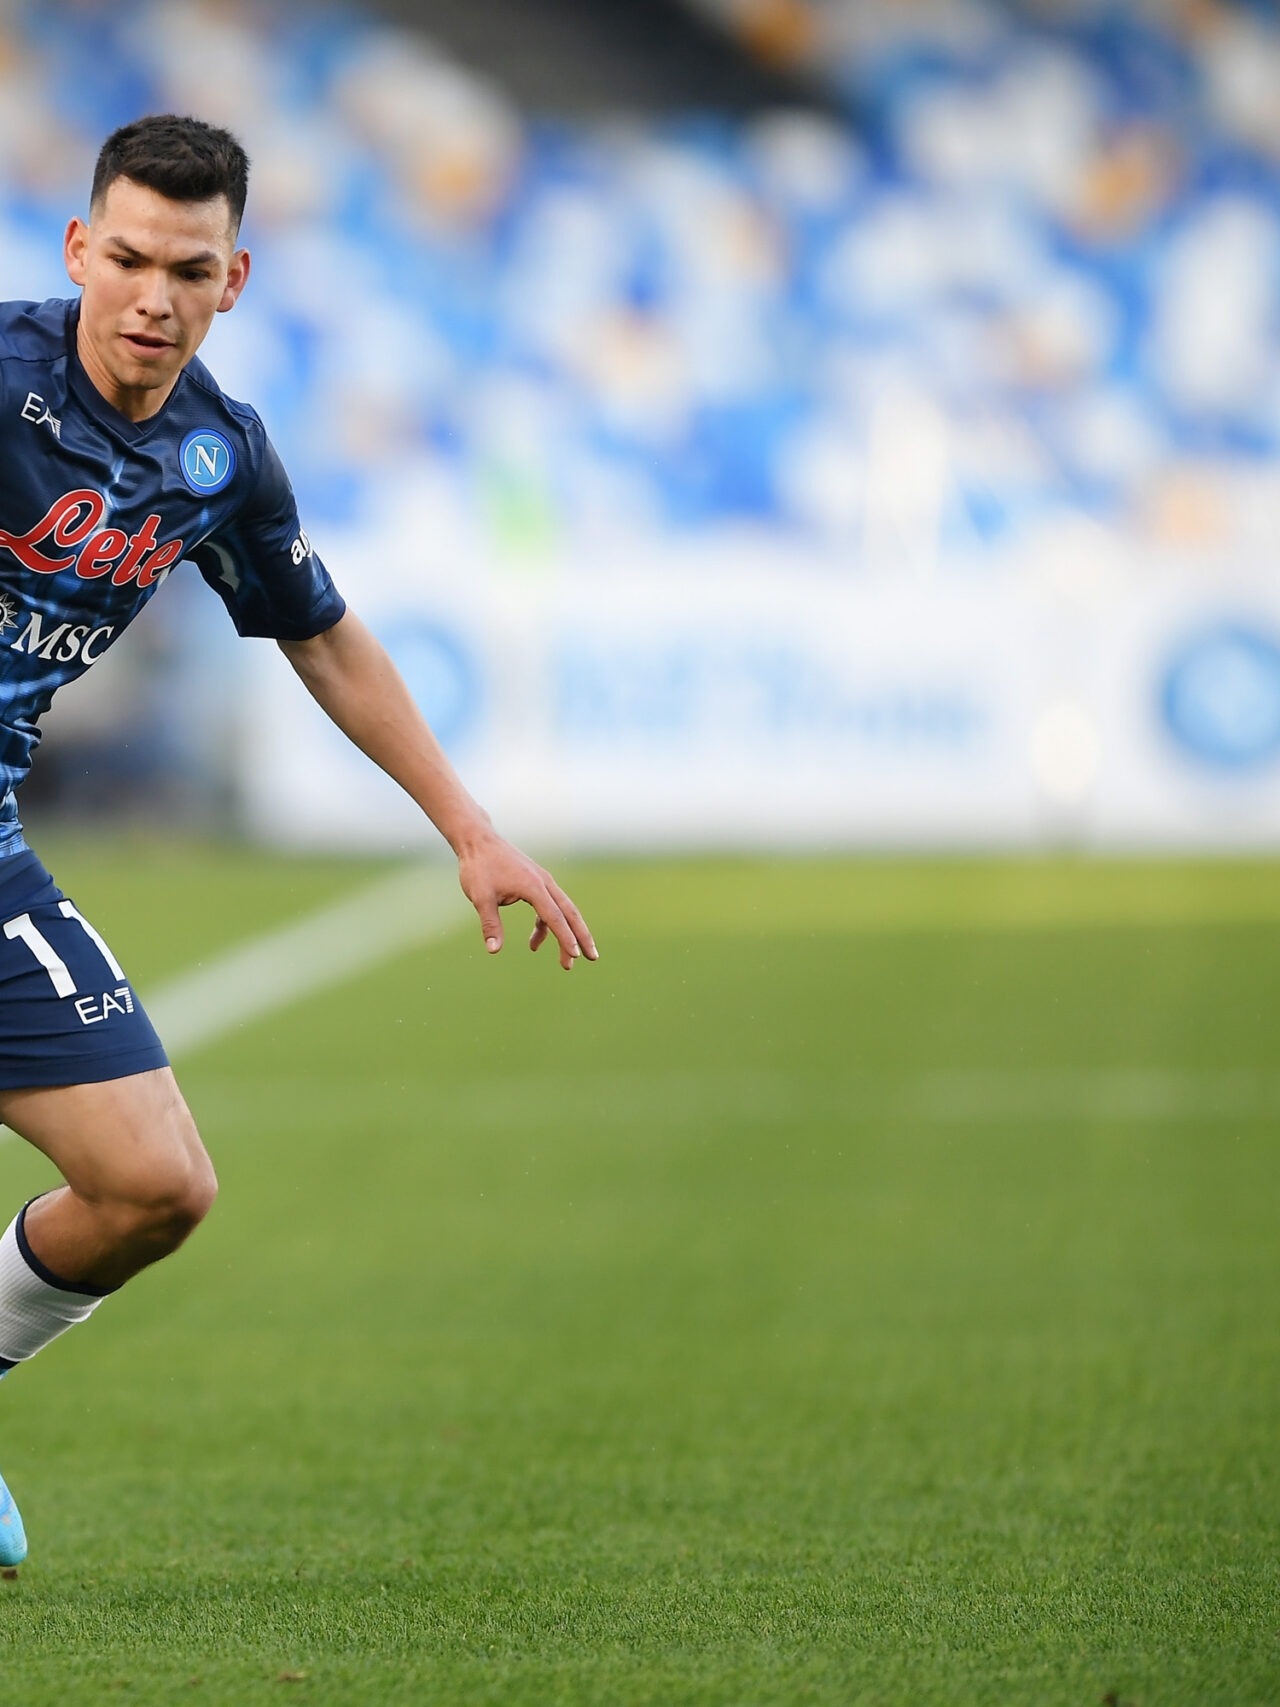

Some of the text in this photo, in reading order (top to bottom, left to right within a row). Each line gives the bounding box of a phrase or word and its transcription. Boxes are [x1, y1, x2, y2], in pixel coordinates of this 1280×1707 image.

[193, 445, 220, 477] N
[10, 611, 115, 665] MSC
[2, 899, 126, 999] 11
[73, 986, 135, 1025] EA7
